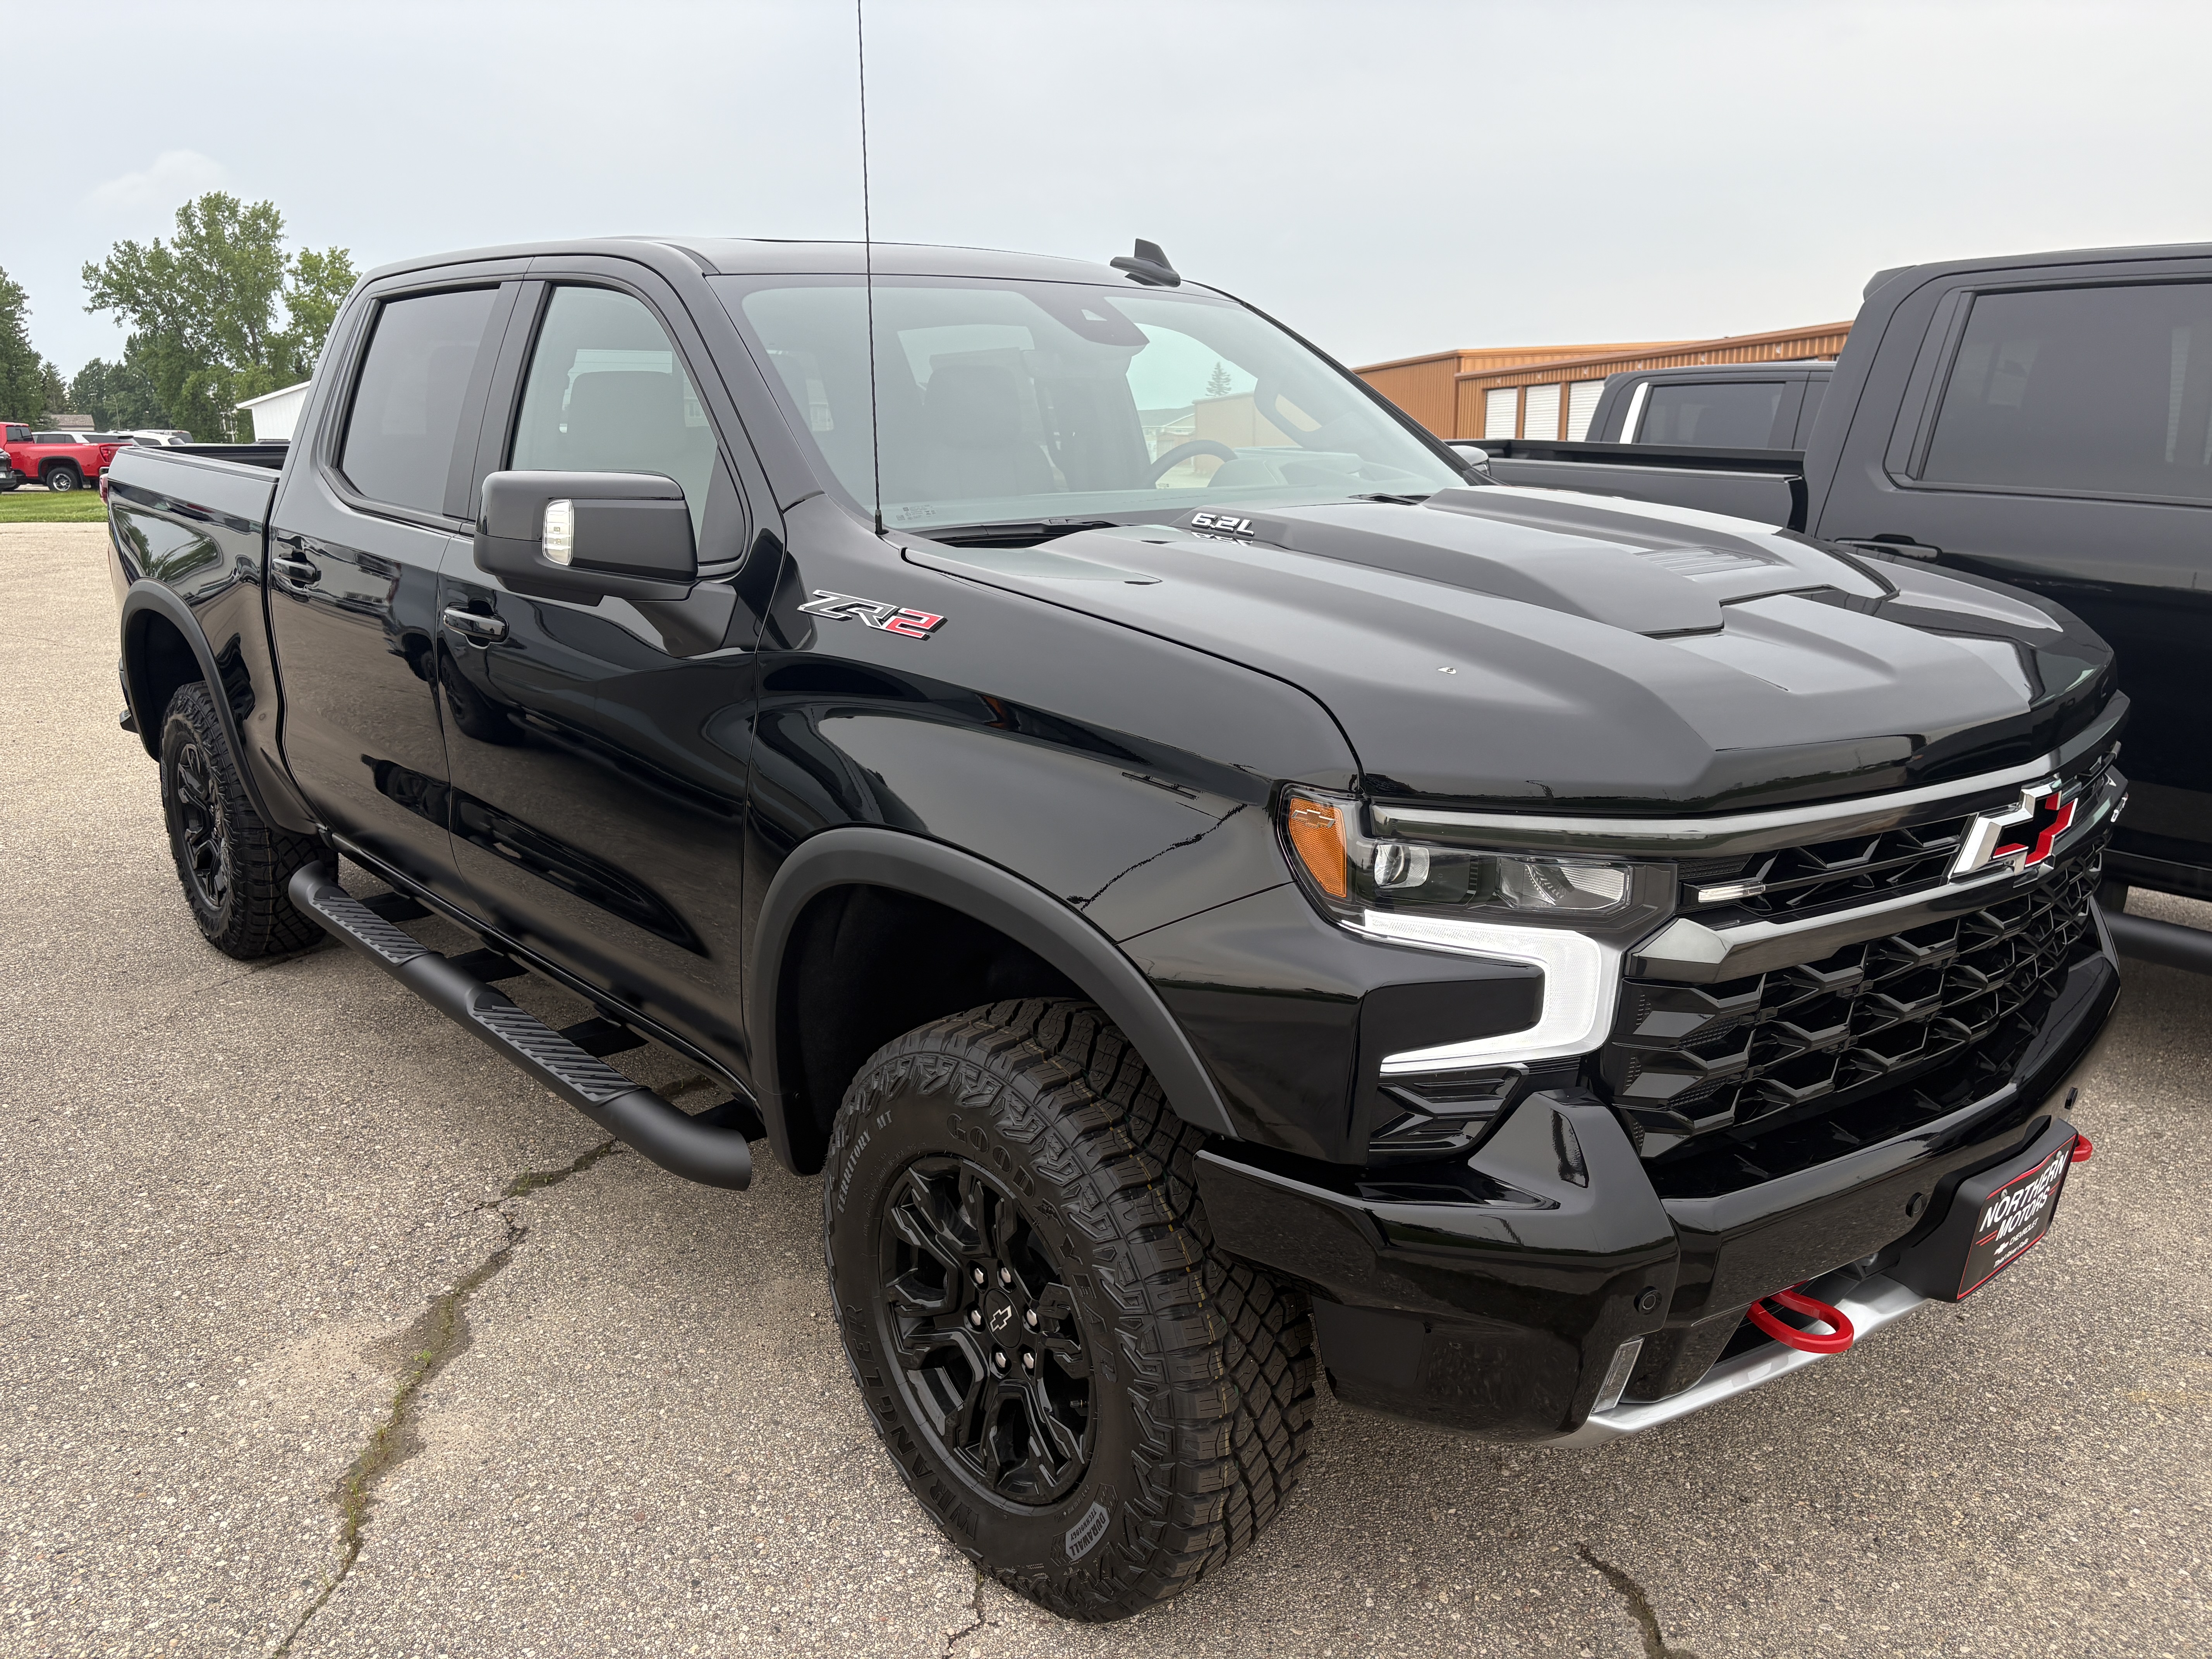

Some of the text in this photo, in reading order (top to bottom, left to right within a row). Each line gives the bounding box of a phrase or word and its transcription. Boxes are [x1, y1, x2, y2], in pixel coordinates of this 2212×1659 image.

[1191, 512, 1254, 536] 6.2L
[797, 589, 948, 641] ZR2
[837, 1127, 871, 1214] TERRITORY
[876, 1109, 892, 1130] MT
[1979, 1150, 2069, 1233] NORTHERN
[1995, 1186, 2051, 1241] MOTORS
[2009, 1217, 2039, 1245] CHEVROLET
[845, 1305, 979, 1540] WRANGLER
[1069, 1511, 1106, 1556] DURAWALL
[1070, 1508, 1097, 1541] TECHNOLOGY
